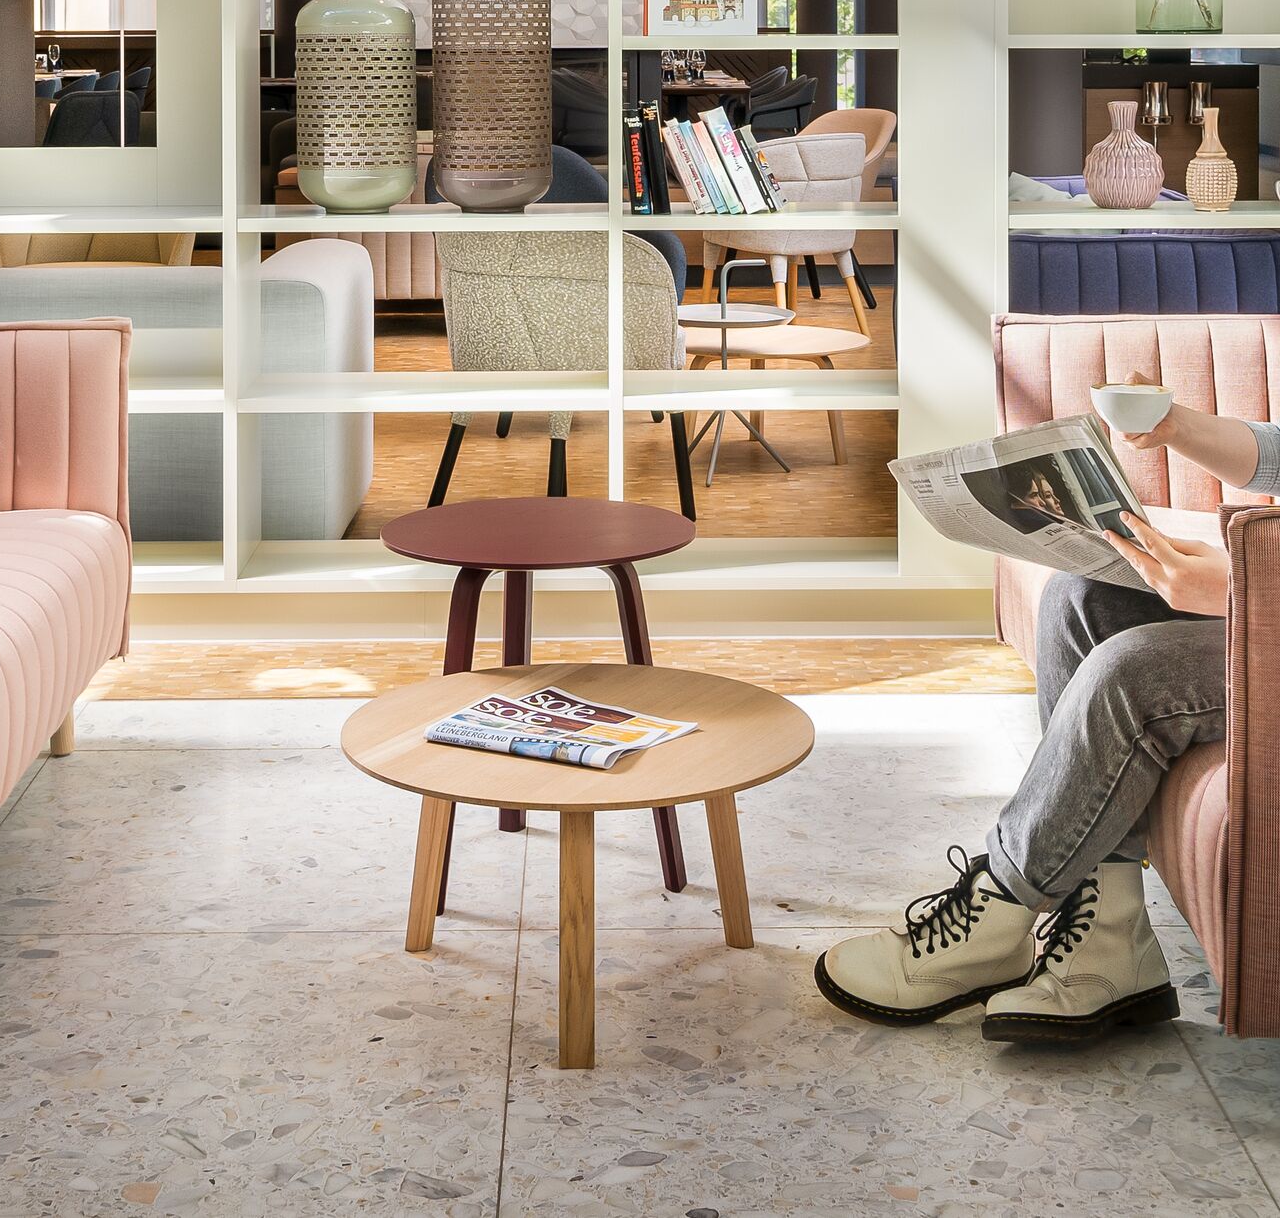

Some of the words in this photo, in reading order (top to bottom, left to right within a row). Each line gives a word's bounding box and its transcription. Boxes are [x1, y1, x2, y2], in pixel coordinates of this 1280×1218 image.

[630, 132, 645, 195] Teufelssaat
[473, 701, 553, 725] sole
[526, 693, 596, 719] sole
[435, 725, 509, 743] LEINEBERGLAND
